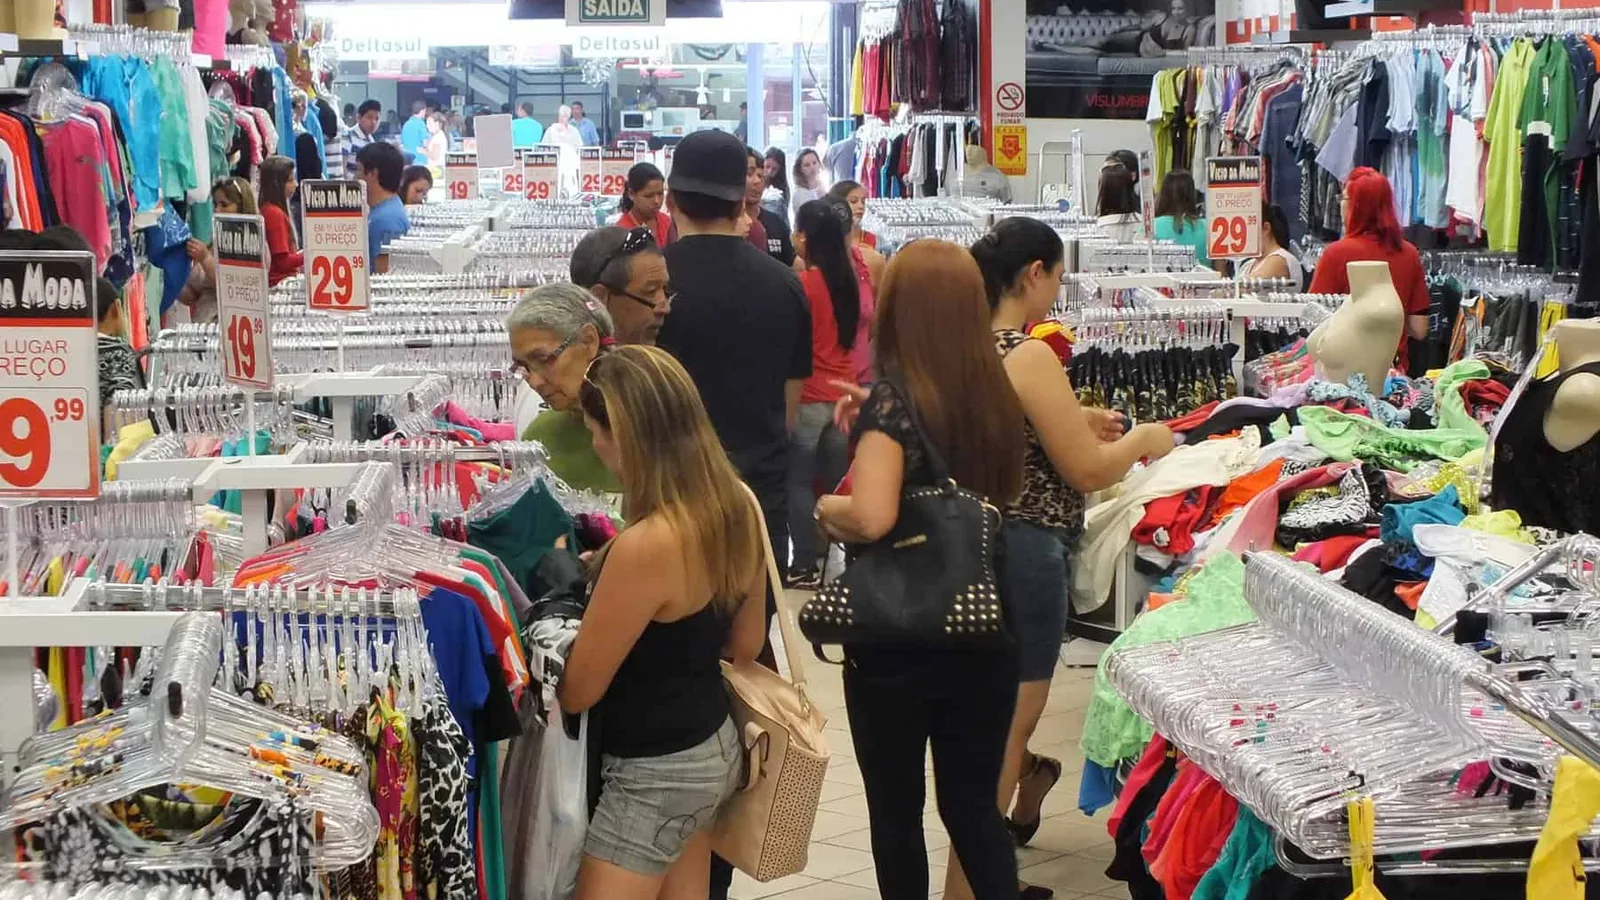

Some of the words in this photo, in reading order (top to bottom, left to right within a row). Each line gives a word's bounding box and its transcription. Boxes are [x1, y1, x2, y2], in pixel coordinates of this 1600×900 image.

[342, 37, 422, 53] Deltasul
[579, 35, 660, 51] Deltasul
[449, 181, 468, 199] 19
[504, 174, 523, 192] 29
[526, 181, 549, 200] 29
[583, 174, 600, 190] 29
[603, 175, 625, 193] 29
[1225, 200, 1252, 209] PREÇO
[334, 224, 357, 232] LUGAR
[1211, 216, 1247, 254] 29
[315, 234, 322, 244] O
[325, 234, 357, 246] PREÇO
[0, 278, 17, 309] A
[21, 263, 87, 310] MODA
[312, 256, 353, 305] 29
[353, 256, 364, 268] 99
[236, 287, 260, 304] PREÇO
[5, 340, 67, 354] LUGAR
[228, 314, 256, 379] 19
[254, 318, 263, 334] 99
